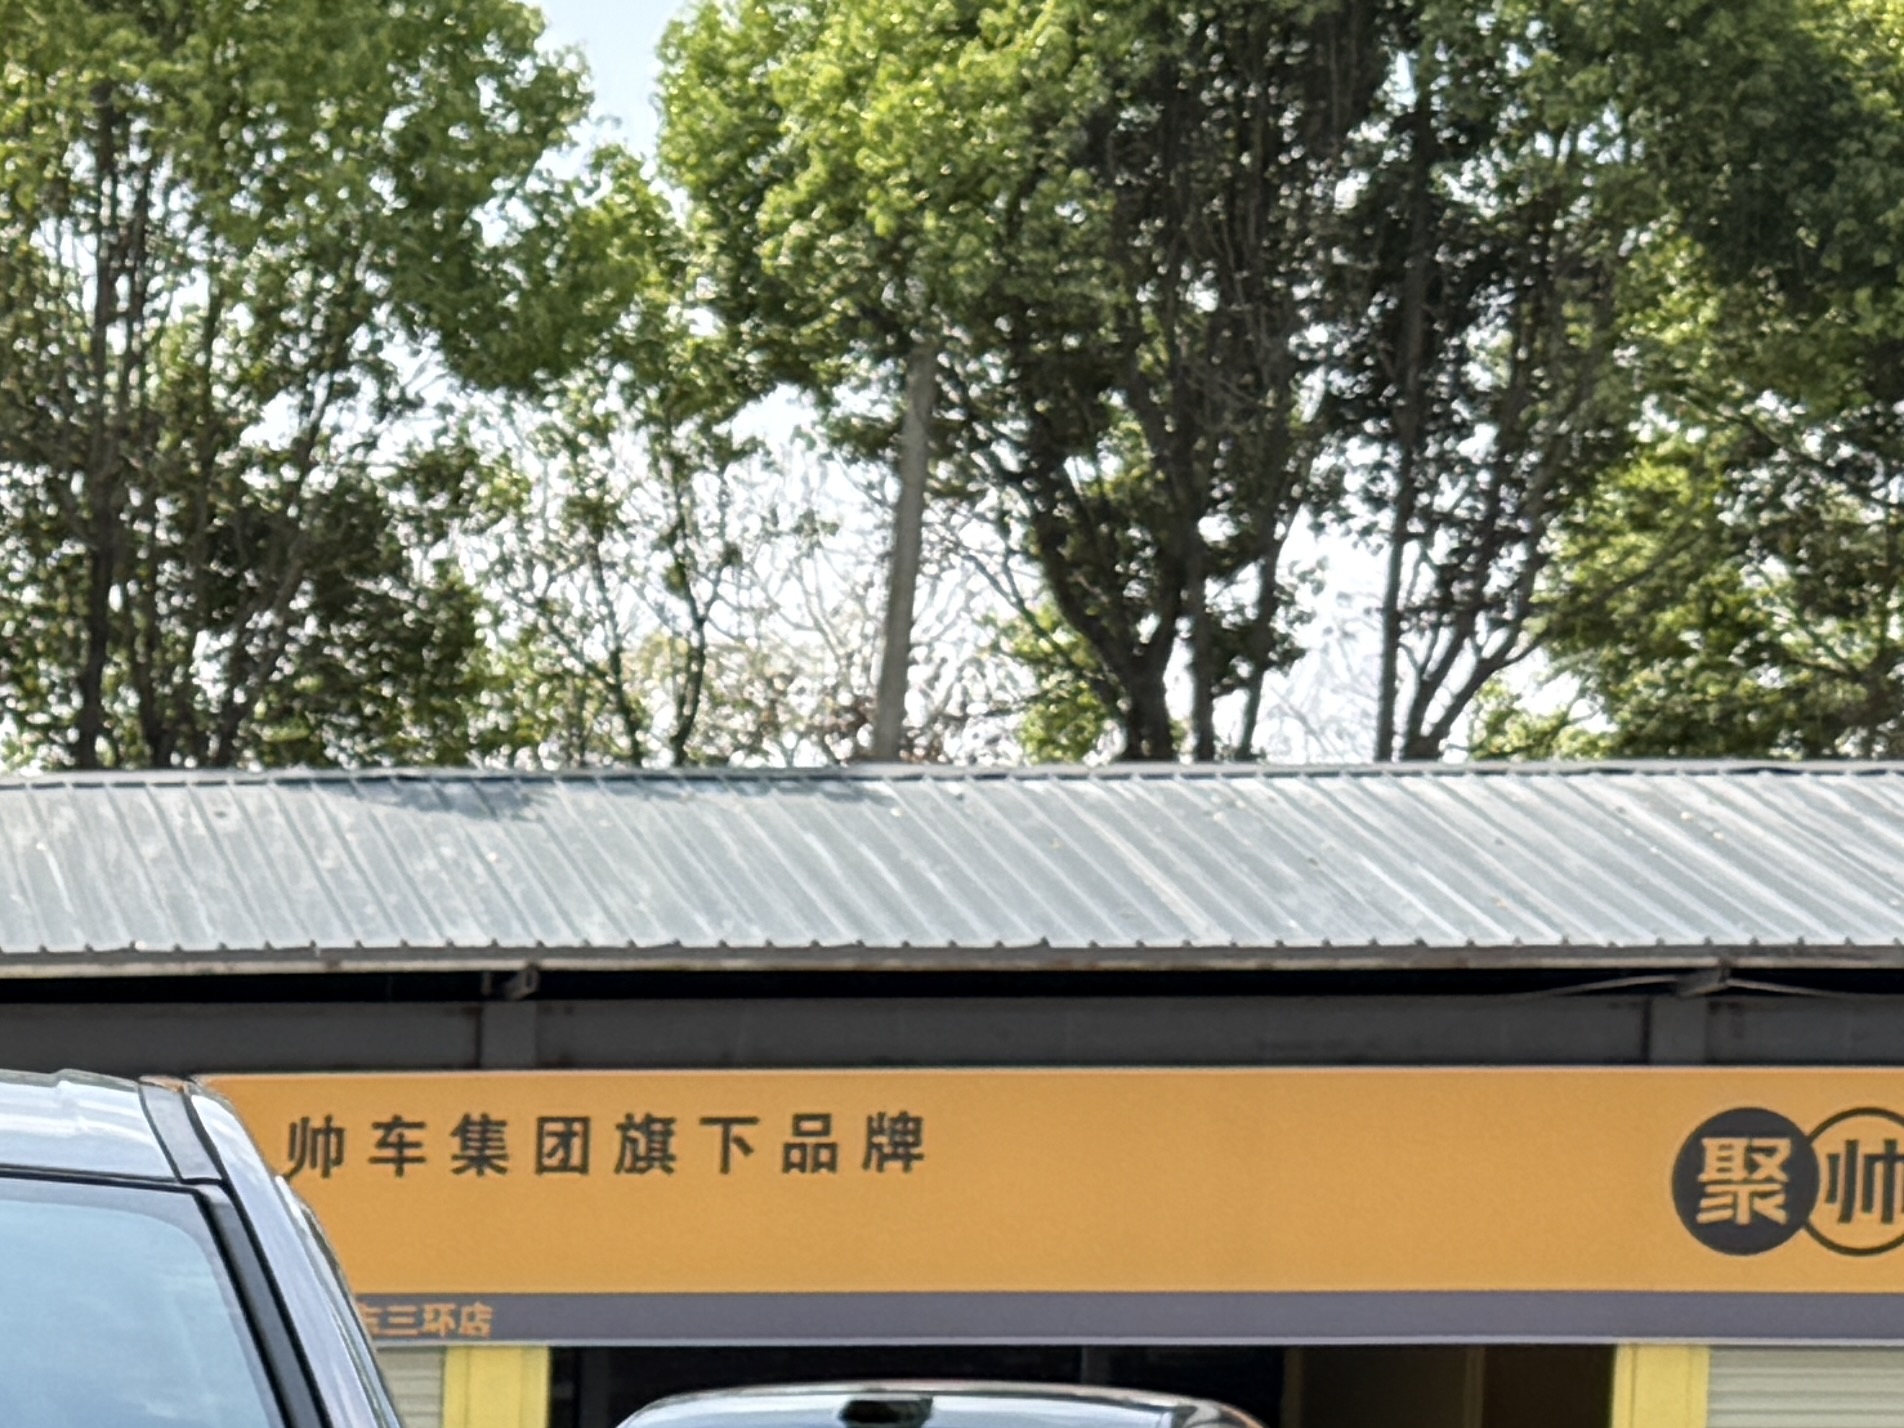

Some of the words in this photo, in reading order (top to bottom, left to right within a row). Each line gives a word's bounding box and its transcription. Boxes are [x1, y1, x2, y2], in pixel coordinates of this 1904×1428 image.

[284, 1110, 927, 1178] 帅车集团旗下品牌
